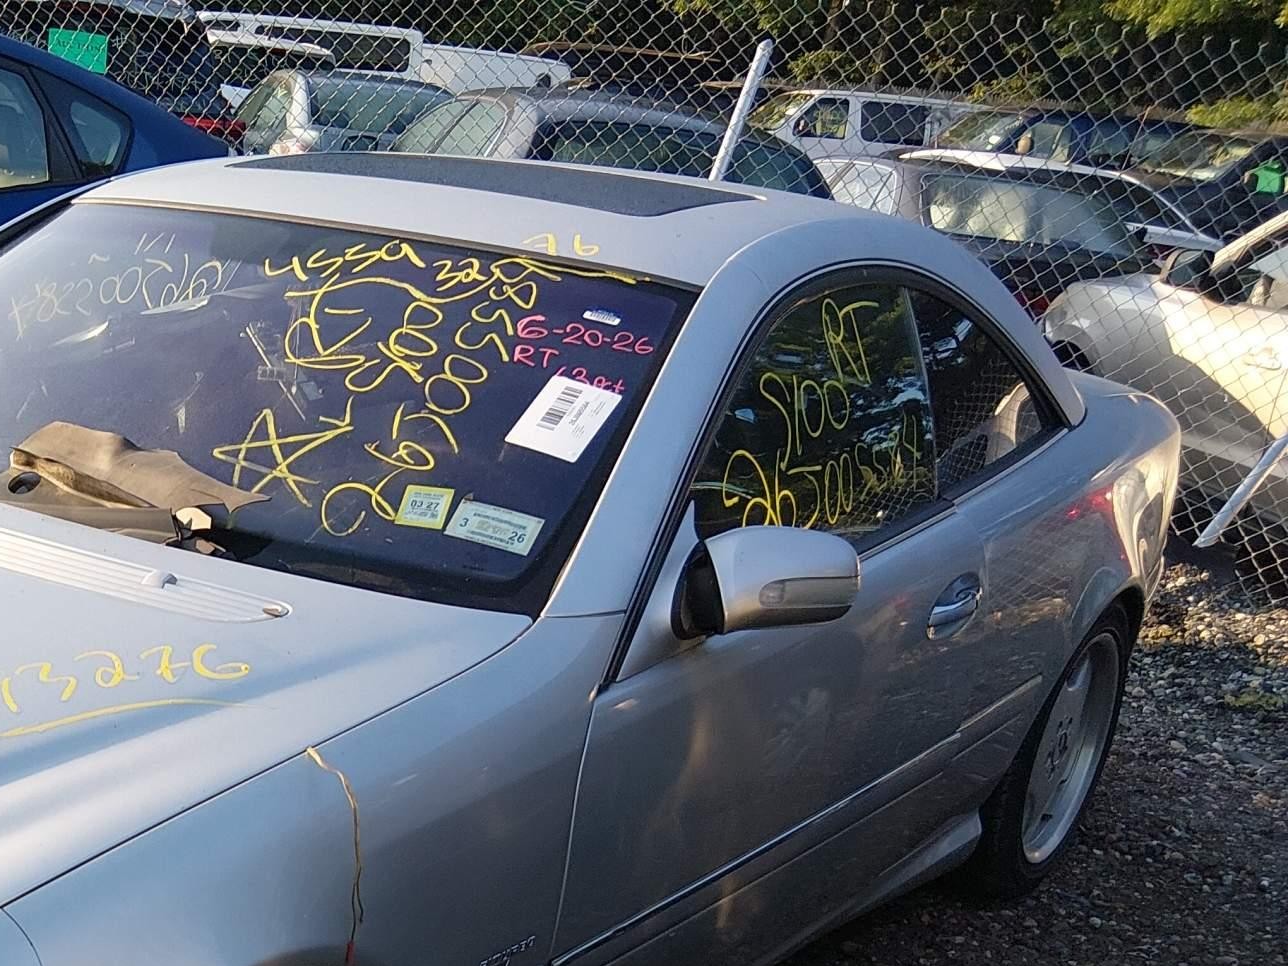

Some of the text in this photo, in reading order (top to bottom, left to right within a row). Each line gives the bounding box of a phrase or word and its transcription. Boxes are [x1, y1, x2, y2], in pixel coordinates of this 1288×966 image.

[516, 314, 654, 355] 6-20-26
[822, 298, 880, 386] RT
[513, 344, 560, 368] RT
[459, 517, 469, 528] 3
[508, 531, 527, 544] 26
